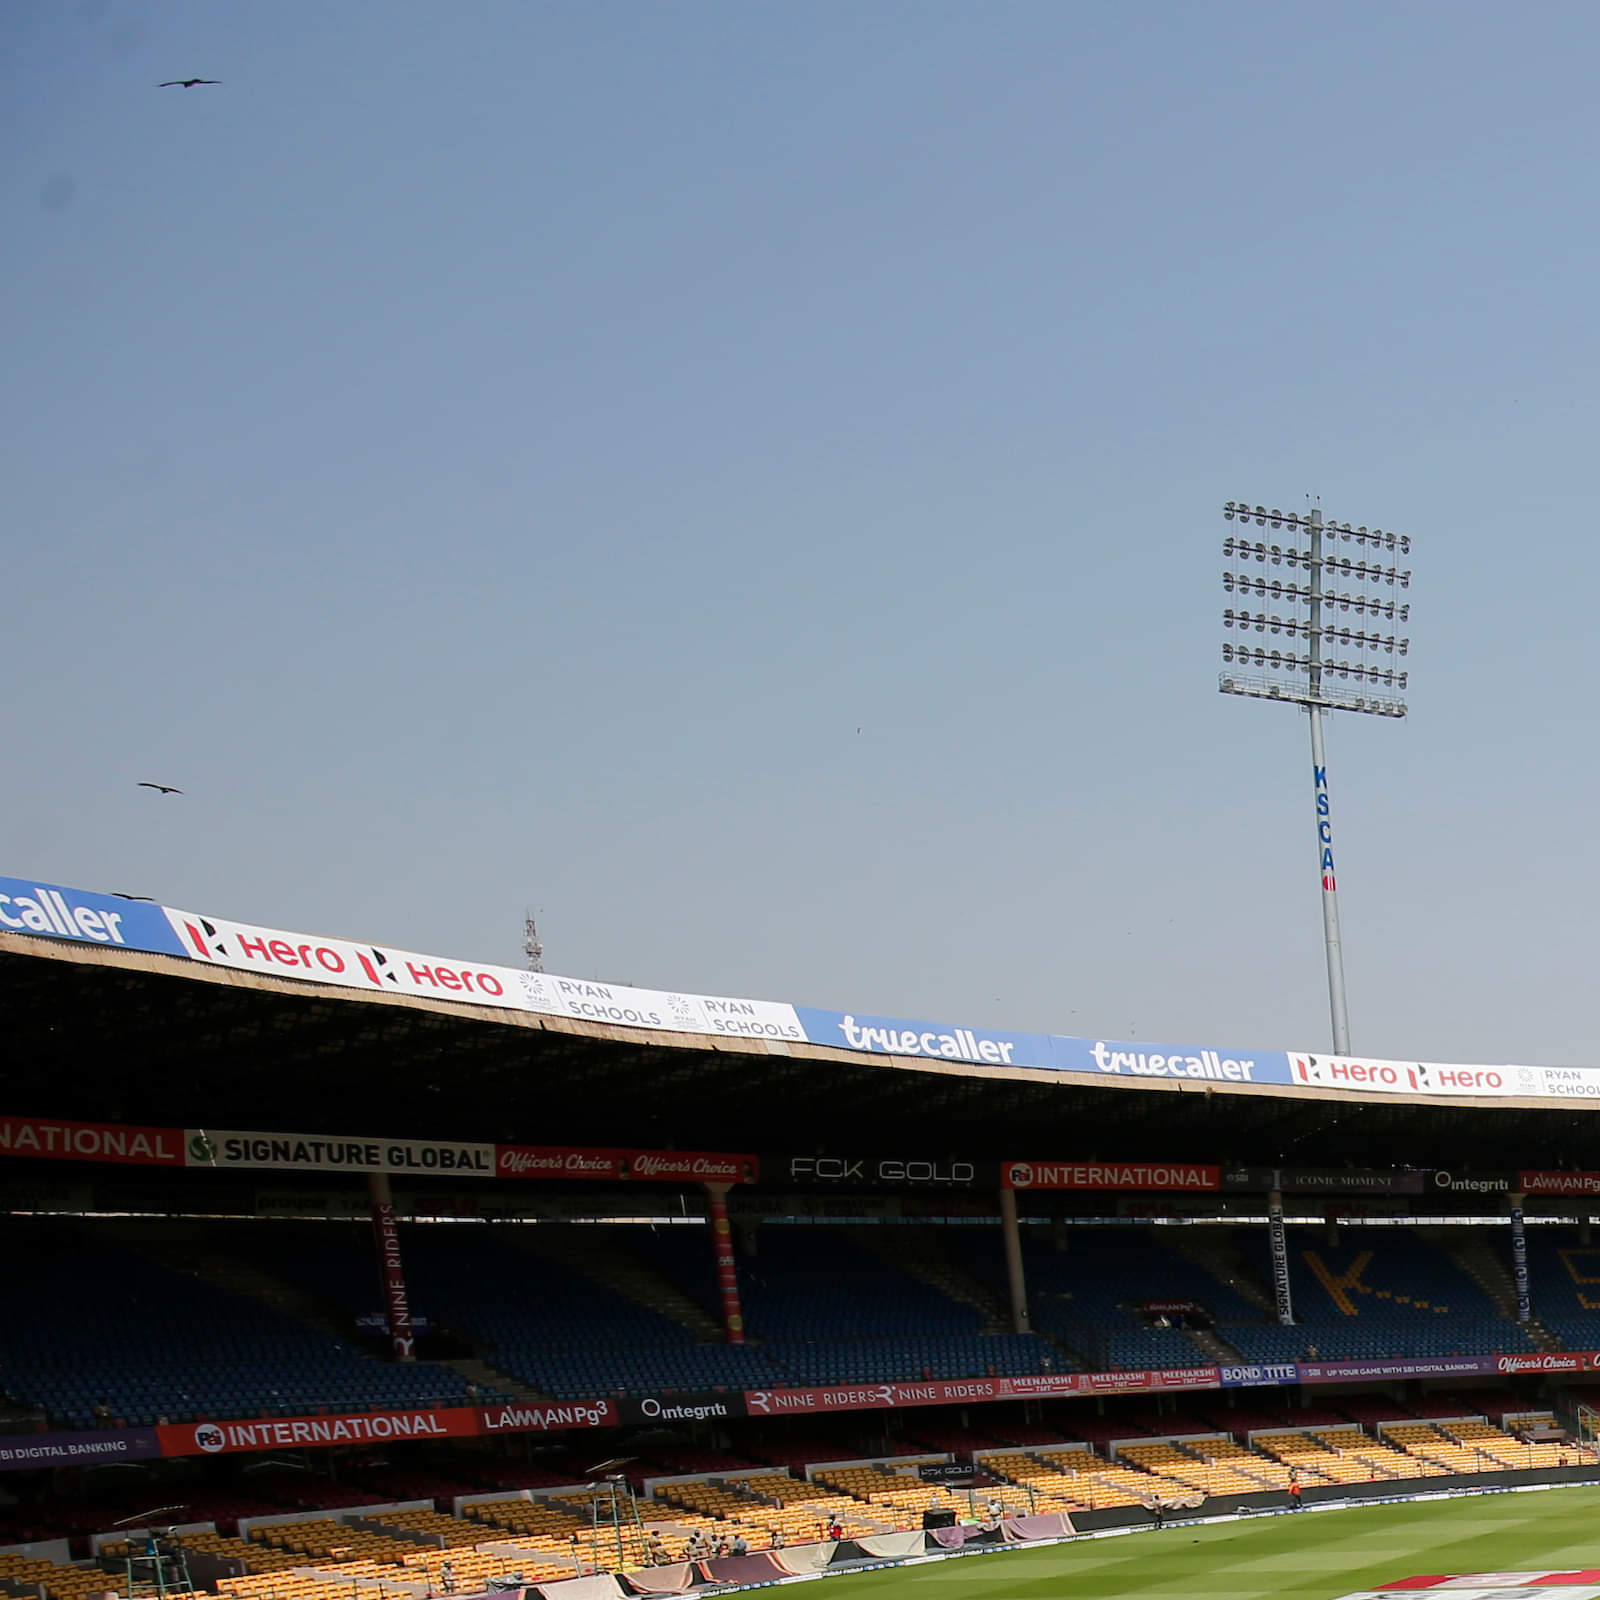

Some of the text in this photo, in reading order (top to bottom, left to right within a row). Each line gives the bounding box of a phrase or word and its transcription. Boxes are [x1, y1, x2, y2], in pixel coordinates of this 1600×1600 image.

[1314, 764, 1336, 871] KSCA
[236, 932, 346, 974] Hero
[406, 960, 504, 997] Hero
[558, 980, 611, 1001] RYAN
[568, 1000, 661, 1026] SCHOOLS
[704, 999, 754, 1017] RYAN
[713, 1019, 800, 1039] SCHOOLS
[838, 1014, 1014, 1064] truecaller
[1089, 1041, 1254, 1082] truecaller
[1330, 1062, 1398, 1084] Hero
[1438, 1069, 1502, 1089] Hero
[1545, 1070, 1581, 1081] RYAN
[224, 1138, 490, 1170] SIGNATURE GLOBAL
[499, 1151, 613, 1173] Officer's Choice
[633, 1154, 738, 1176] Officer's Choice
[878, 1160, 976, 1182] GOLD
[1036, 1166, 1215, 1187] INTERNATIONAL
[1498, 1353, 1577, 1371] Officer's Choice
[1012, 1374, 1073, 1387] MEENAKSHI
[1091, 1372, 1146, 1385] MEENAKSHI
[1161, 1369, 1216, 1382] MEENAKSHI
[1222, 1366, 1261, 1382] BOND
[775, 1390, 877, 1408] NINE RIDERS
[898, 1383, 994, 1401] NINE RIDERS
[228, 1412, 447, 1448] INTERNATIONAL
[16, 1440, 128, 1460] DIGITAL BANKING
